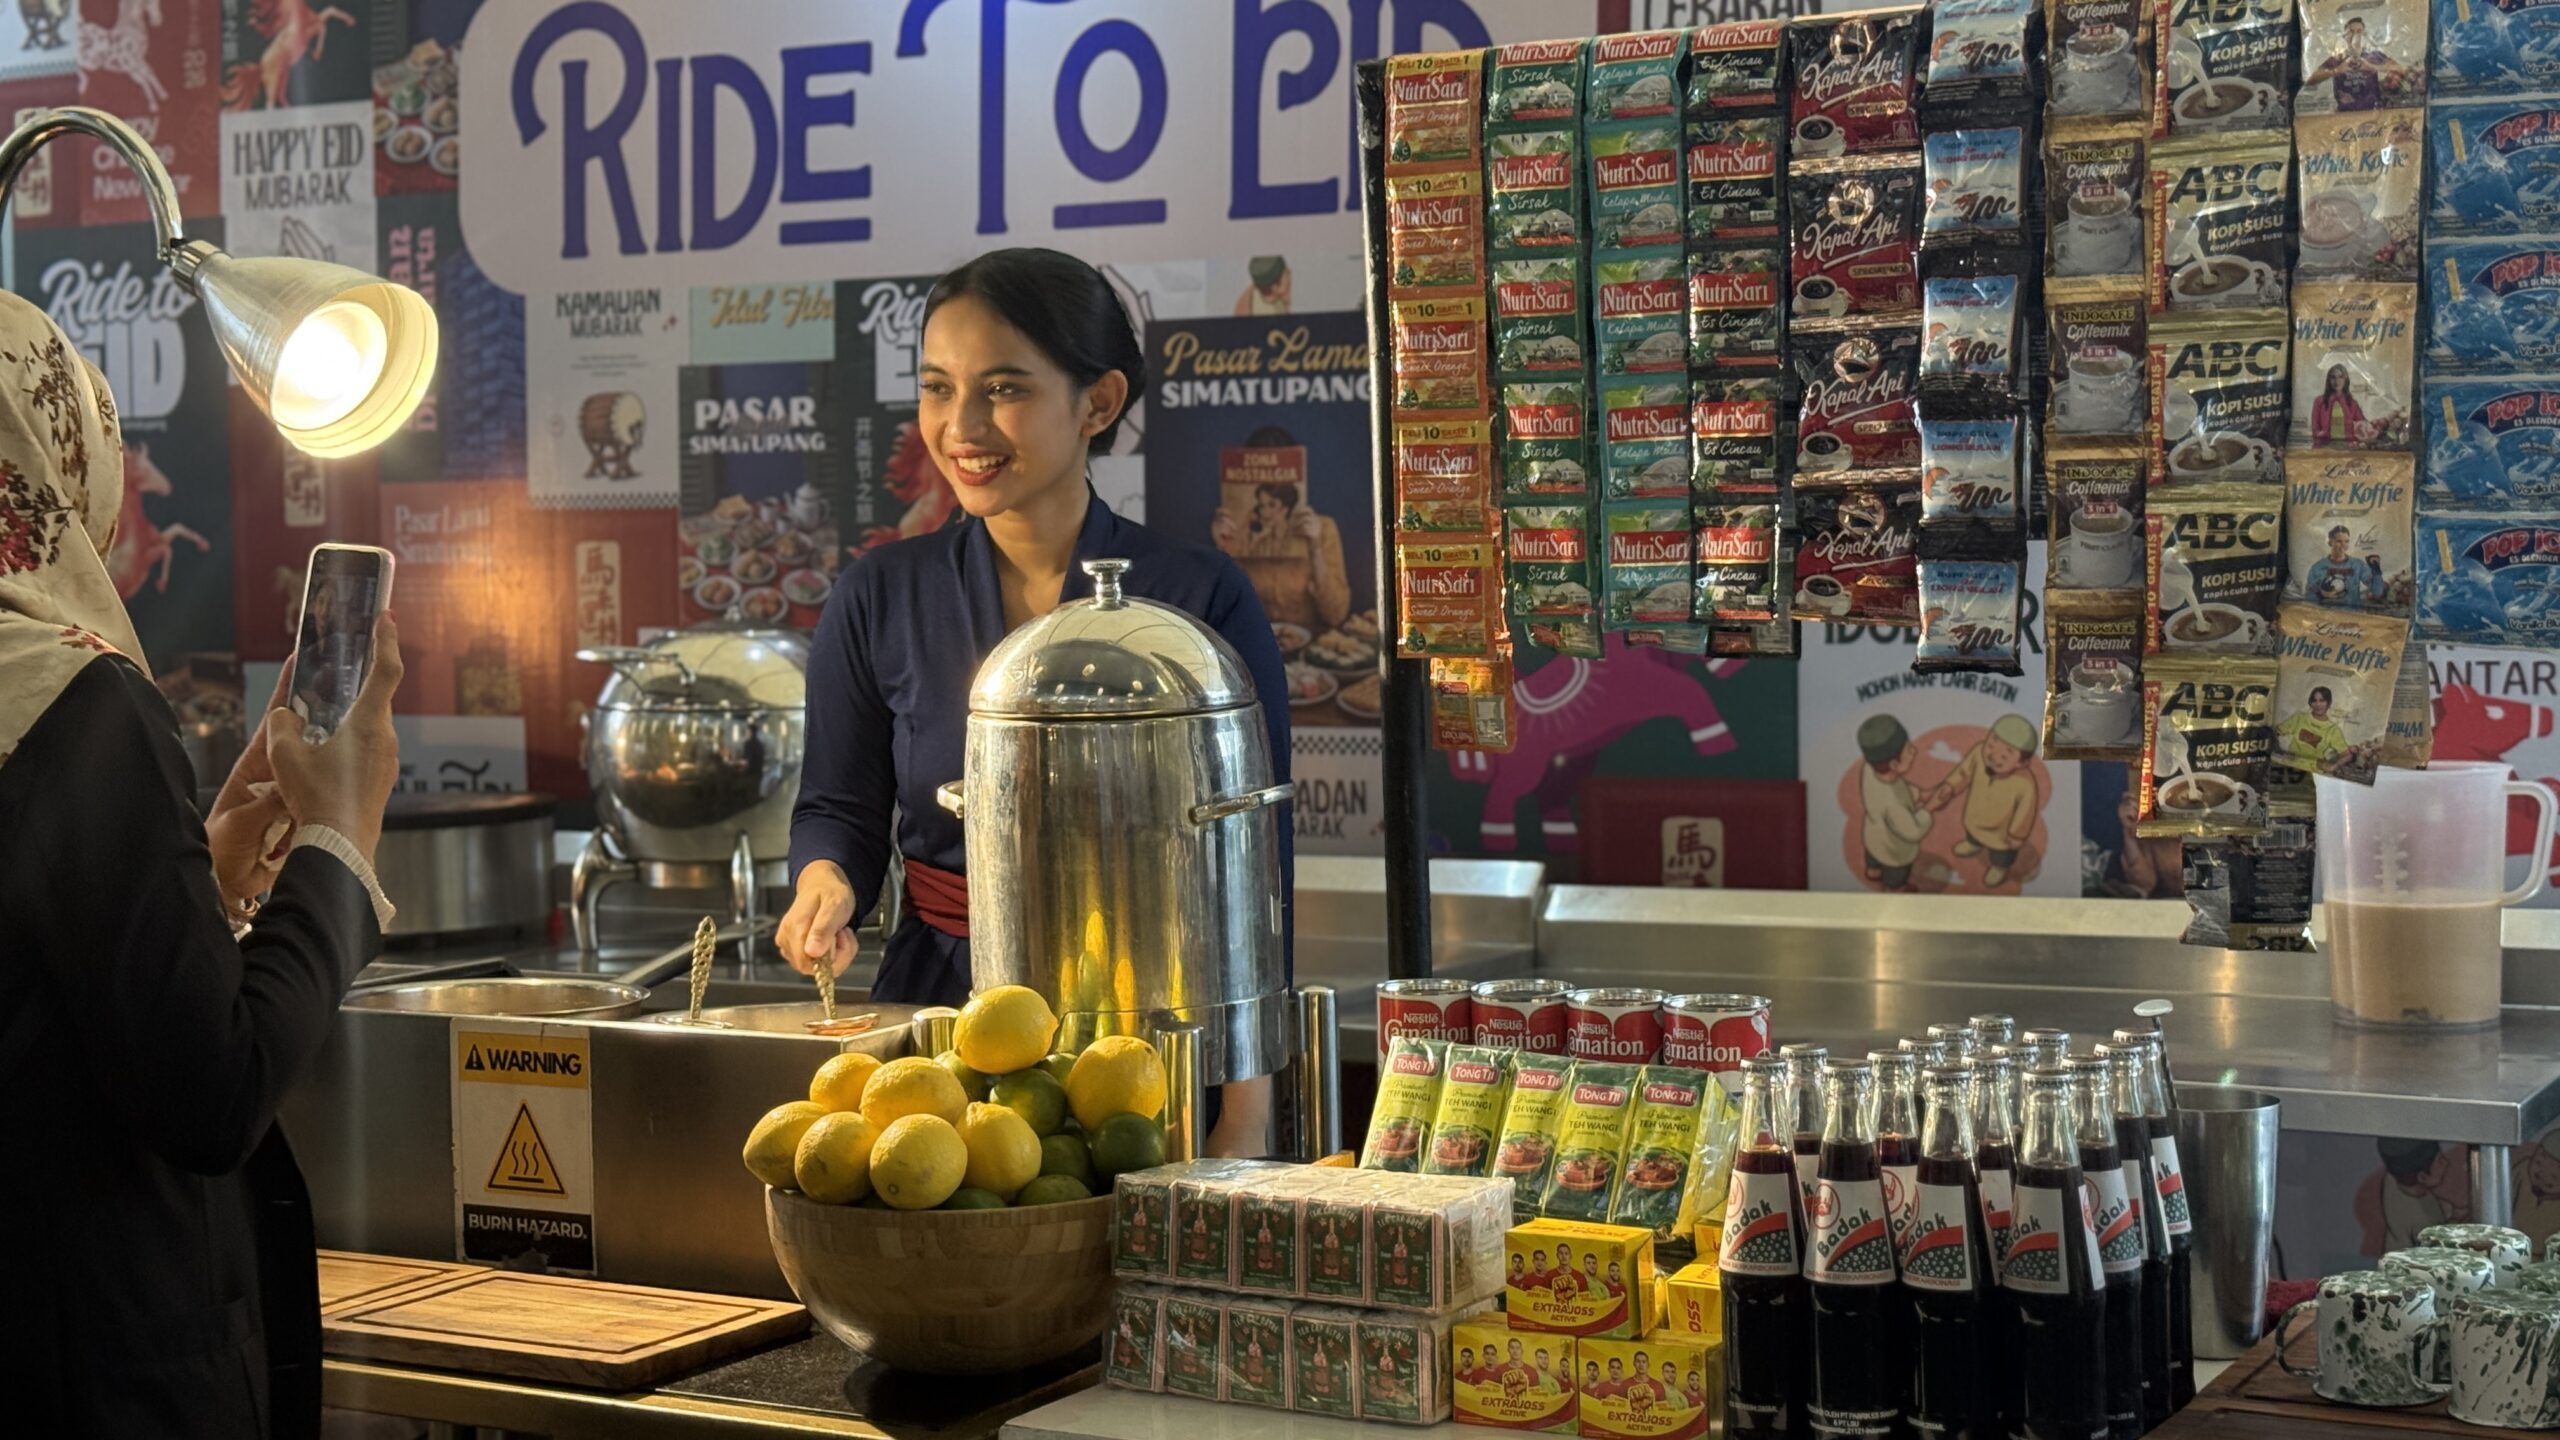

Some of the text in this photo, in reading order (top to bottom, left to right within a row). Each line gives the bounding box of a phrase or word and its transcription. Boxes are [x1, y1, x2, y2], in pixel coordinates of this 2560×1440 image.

[2066, 2, 2130, 21] Coffeemix
[1597, 37, 1671, 60] NutriSari
[1697, 27, 1773, 47] NutriSari
[2210, 35, 2289, 63] KOPI SUSU
[1417, 58, 1433, 69] 10
[1508, 68, 1553, 83] Sirsak
[1802, 51, 1902, 100] Kapal Api
[1394, 74, 1465, 101] NutriSari
[511, 0, 873, 258] RIDE
[2494, 112, 2543, 149] POP
[233, 127, 318, 176] HAPPY
[1693, 147, 1767, 174] NutriSari
[1496, 160, 1564, 188] NutriSari
[1597, 156, 1669, 186] NutriSari
[2066, 162, 2130, 179] Coffeemix
[2167, 161, 2284, 204] ABC
[245, 172, 352, 211] MUBARAK
[1416, 179, 1431, 193] 10
[1394, 199, 1464, 227] NutriSari
[1508, 194, 1552, 211] Sirsak
[1802, 212, 1902, 263] Kapal Api
[2207, 214, 2284, 241] KOPI SUSU
[2491, 256, 2539, 290] POP
[40, 259, 145, 340] Ride
[1501, 284, 1568, 311] NutriSari
[1603, 285, 1677, 313] NutriSari
[1693, 276, 1768, 304] NutriSari
[1418, 304, 1434, 317] 10
[2064, 307, 2135, 322] INDOCAFE
[1401, 325, 1469, 352] NutriSari
[1514, 320, 1557, 336] Sirsak
[2066, 323, 2131, 341] Coffeemix
[2296, 319, 2406, 344] White Koffie
[1163, 325, 1372, 377] Pasar Lama
[2166, 340, 2283, 379] ABC
[1434, 361, 1470, 376] Orange
[1807, 370, 1906, 416] Kapal Api
[2206, 393, 2283, 417] KOPI SUSU
[694, 396, 816, 430] PASAR
[1509, 408, 1574, 434] NutriSari
[1610, 410, 1684, 437] NutriSari
[1698, 406, 1767, 430] NutriSari
[2486, 394, 2534, 429] POP
[2514, 418, 2525, 427] ES
[689, 432, 827, 455] SIMATUPANG
[1423, 426, 1440, 439] 10
[1243, 453, 1279, 467] ZONA
[1402, 447, 1473, 474] NutriSari
[1521, 442, 1562, 458] Sirsak
[1225, 467, 1297, 482] NOSTALGIA
[2068, 480, 2131, 496] Coffeemix
[2291, 482, 2404, 508] White Koffie
[2163, 512, 2276, 550] ABC
[1424, 548, 1441, 562] 10
[1512, 532, 1579, 557] NutriSari
[1613, 536, 1690, 560] NutriSari
[1700, 533, 1763, 557] NutriSari
[1814, 526, 1912, 563] Kapal Api
[2481, 532, 2527, 564] POP
[2147, 533, 2158, 584] GRATIS
[2509, 555, 2519, 563] ES
[1405, 569, 1475, 596] NutriSari
[1527, 565, 1568, 581] Sirsak
[2201, 566, 2277, 588] KOPI SUSU
[1439, 605, 1475, 621] Orange
[2064, 622, 2136, 635] INDOCAFE
[2067, 636, 2132, 651] Coffeemix
[2279, 634, 2391, 672] White Koffie
[1979, 674, 2019, 703] BATIN
[2160, 681, 2271, 721] ABC
[2196, 738, 2270, 757] KOPI SUSU
[1295, 779, 1367, 815] ADAN
[2140, 785, 2151, 814] BELI
[1297, 816, 1346, 838] ARAK
[1474, 1023, 1557, 1049] Carnation
[1567, 1028, 1645, 1058] Carnation
[1663, 1033, 1742, 1065] Carnation
[487, 1048, 582, 1076] WARNING
[1395, 1057, 1421, 1071] TONG
[1455, 1067, 1482, 1079] TONG
[1518, 1074, 1546, 1086] TONG
[1445, 1098, 1492, 1110] TEH WANGI
[1579, 1088, 1608, 1101] TONG
[1650, 1088, 1678, 1101] TONG
[1569, 1119, 1619, 1132] TEH WANGI
[1639, 1119, 1691, 1133] TEH WANGI
[468, 1213, 587, 1240] BURN HAZARD.
[1724, 1200, 1773, 1246] Badak
[1816, 1206, 1872, 1257] Badak
[1532, 1300, 1595, 1317] EXTRAJOSS
[1550, 1313, 1578, 1323] ACTIVE
[1480, 1396, 1546, 1412] EXTRAJOSS
[1499, 1408, 1527, 1418] ACTIVE
[1606, 1411, 1673, 1427] EXTRAJOSS
[1625, 1422, 1655, 1433] ACTIVE
